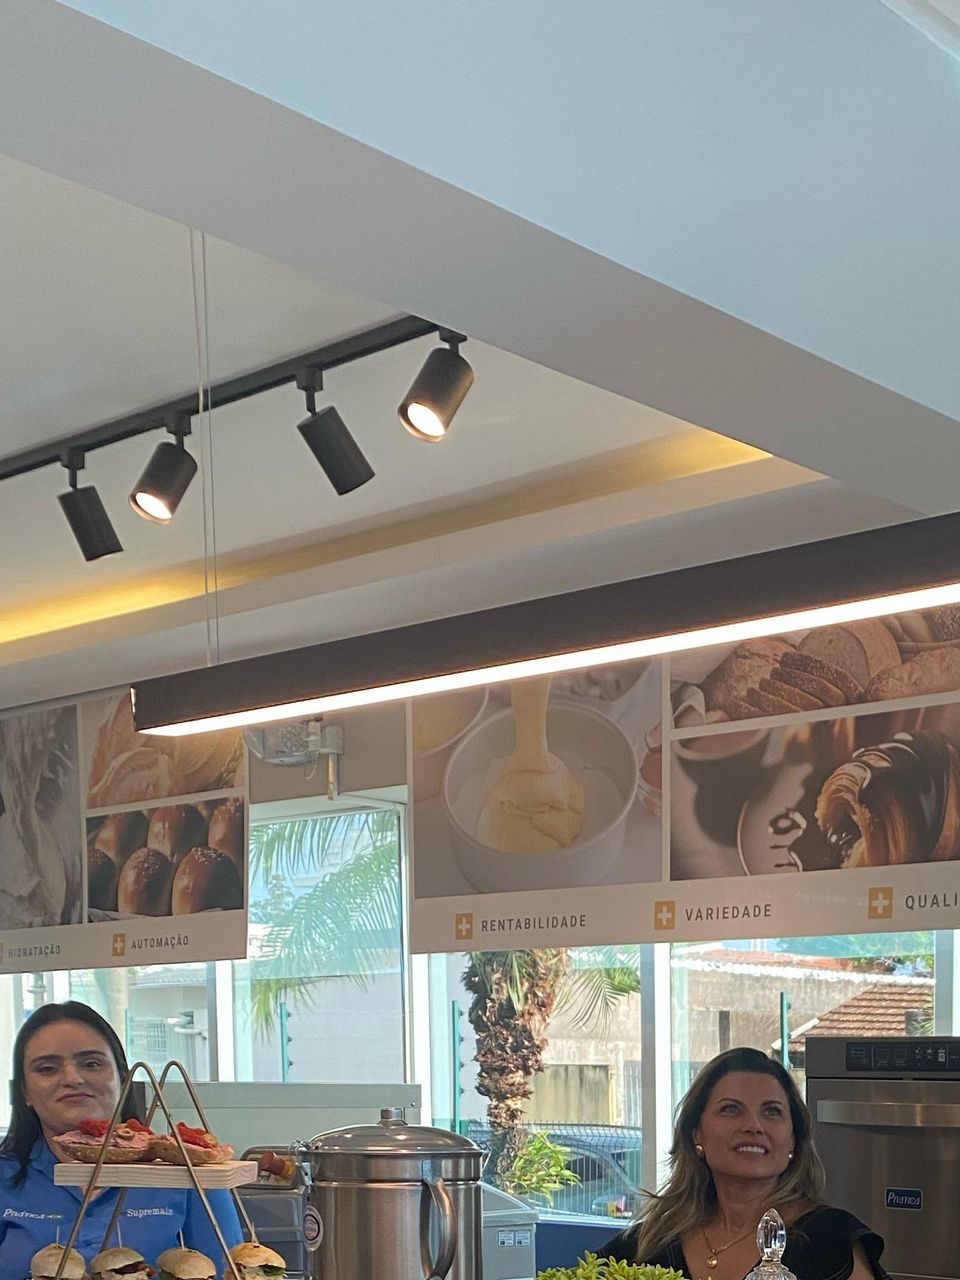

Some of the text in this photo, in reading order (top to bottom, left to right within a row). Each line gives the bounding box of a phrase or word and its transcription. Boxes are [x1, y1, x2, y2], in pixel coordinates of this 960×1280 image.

[685, 904, 773, 921] VARIEDADE
[481, 915, 586, 932] RENTABILIDADE
[131, 934, 188, 950] AUTOMAÇÃO
[8, 943, 61, 958] HIDRATAÇÃO
